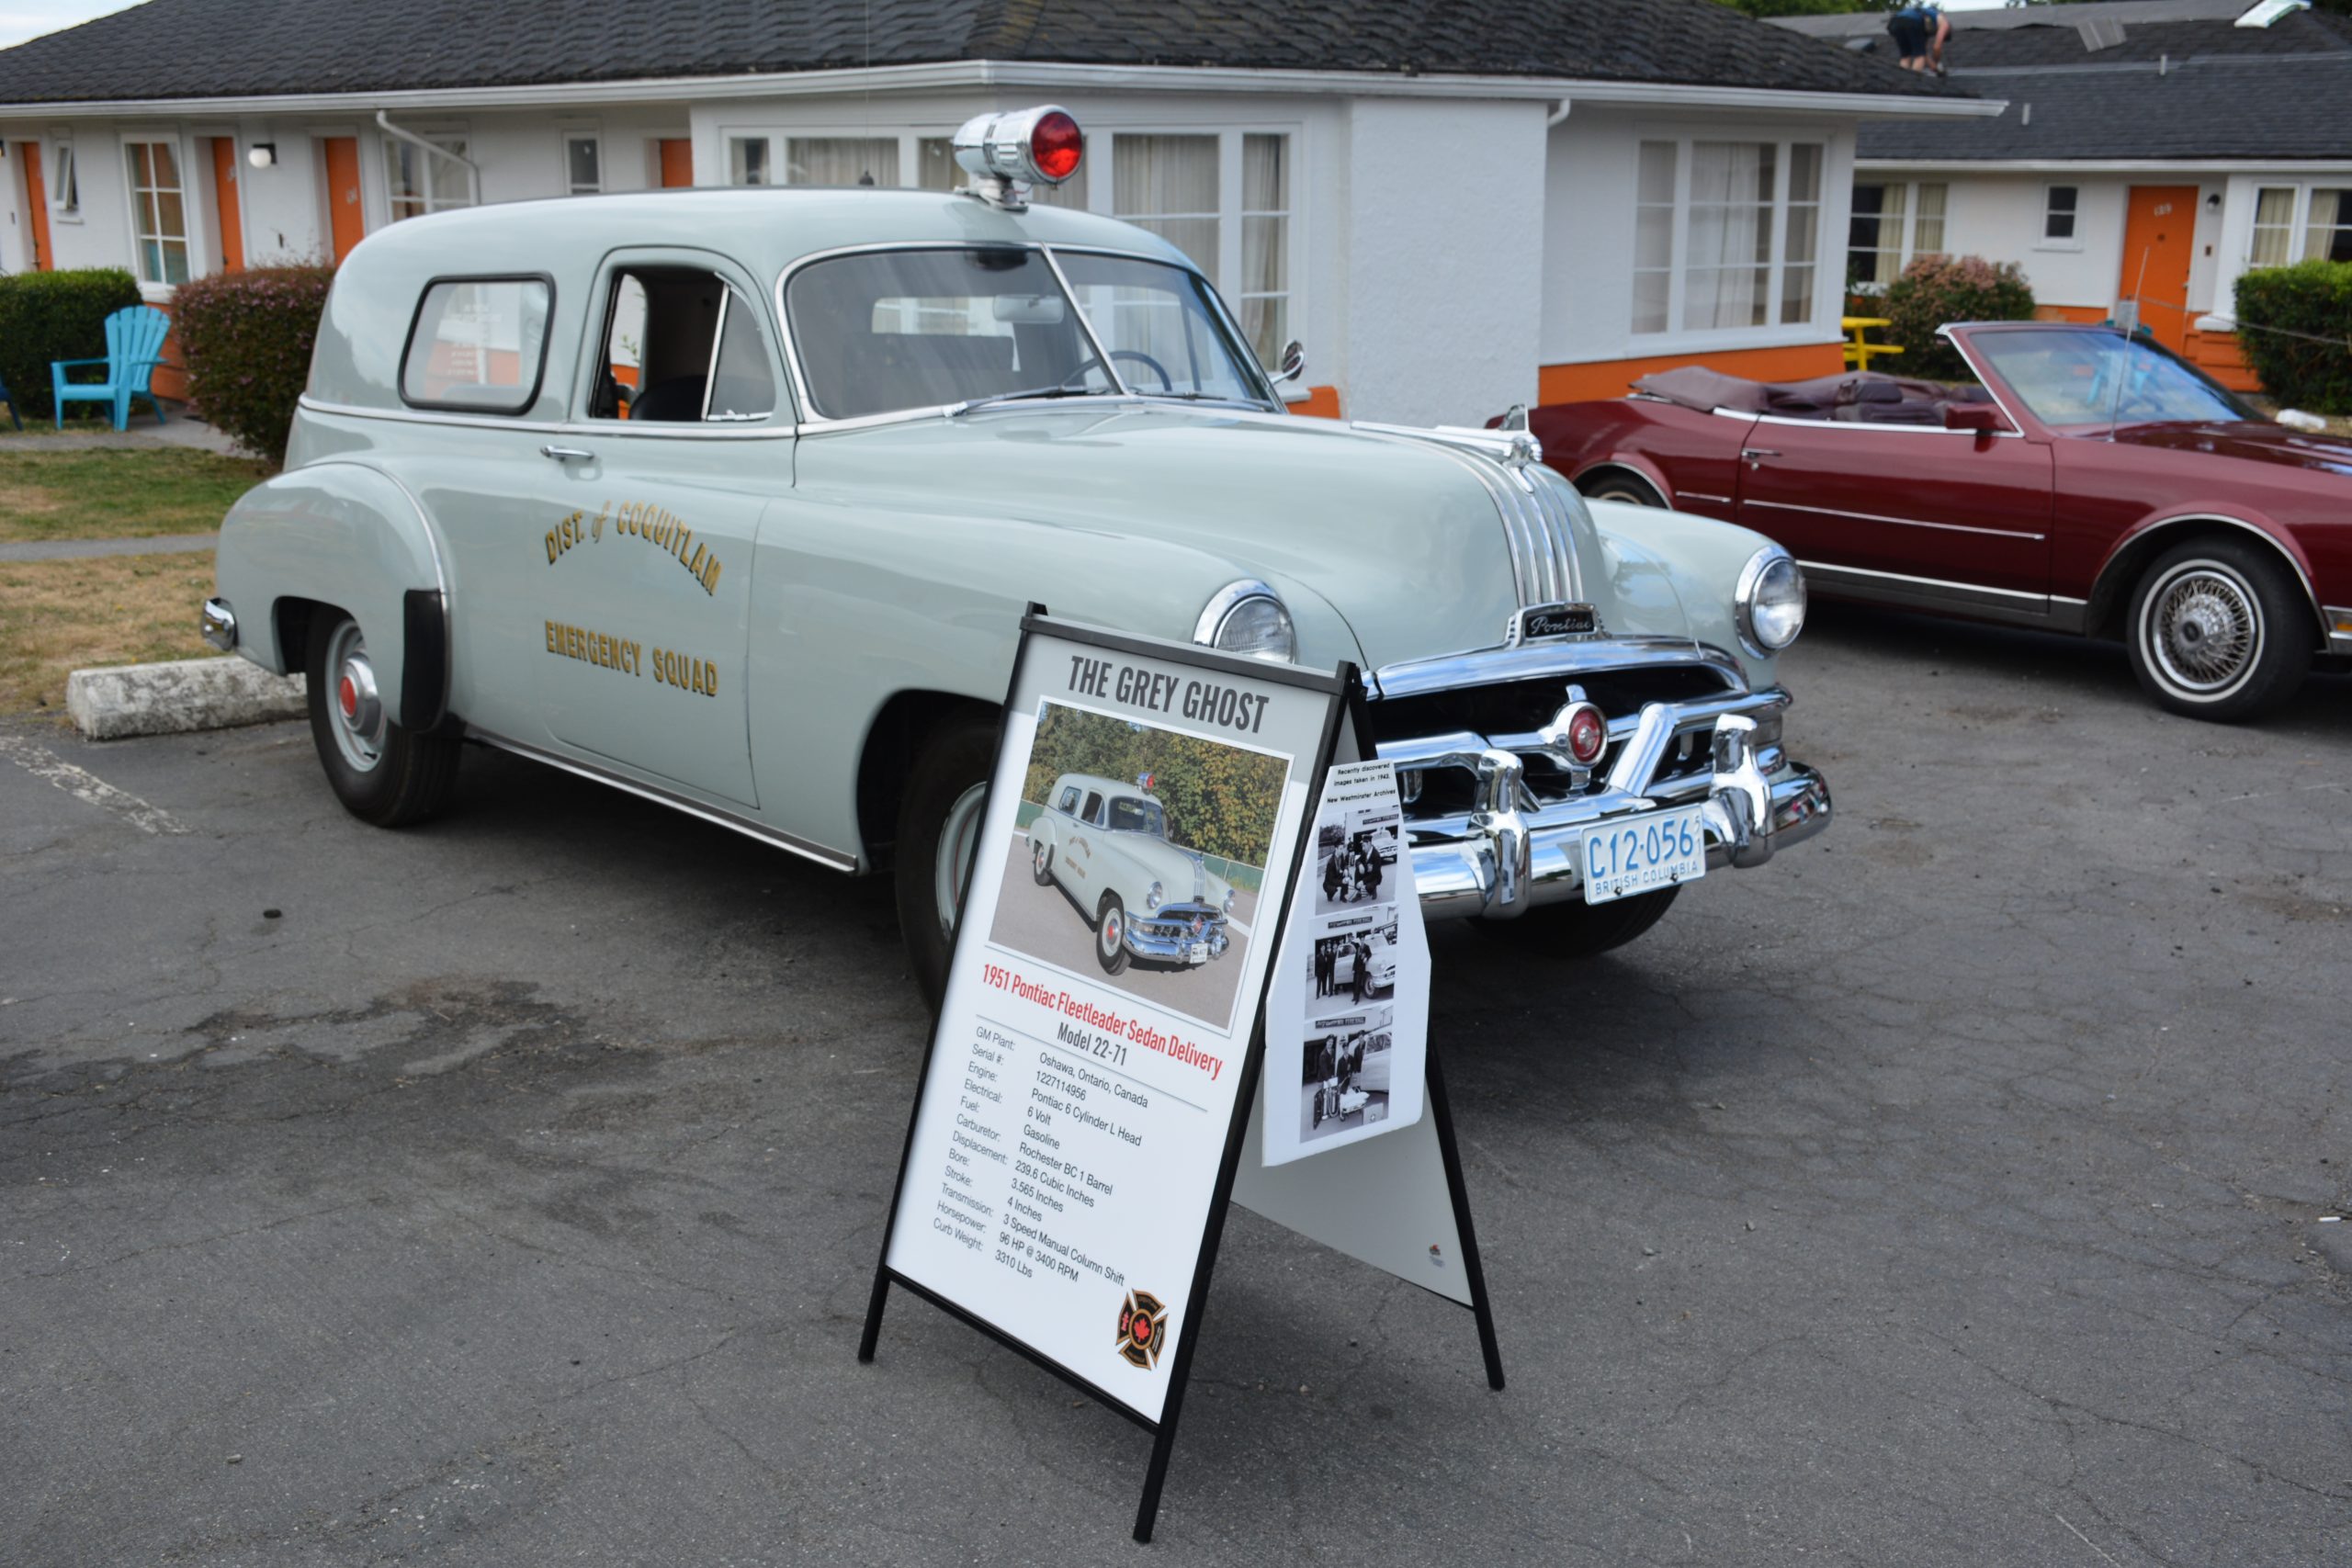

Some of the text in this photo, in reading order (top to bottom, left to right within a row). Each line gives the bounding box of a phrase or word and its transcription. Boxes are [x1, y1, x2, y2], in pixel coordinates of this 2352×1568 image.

[545, 500, 723, 597] DIST. of COQUITLAM
[1531, 615, 1592, 635] Pontiac
[545, 619, 718, 697] EMERGENCY SQUAD
[1068, 655, 1270, 734] THE GREY GHOST
[1338, 763, 1390, 775] Recently discovered
[1340, 793, 1372, 801] Westminster
[1596, 861, 1698, 895] BRITISH COLUMBIA
[976, 1026, 1015, 1051] GM Plant:
[982, 964, 1224, 1081] 1951 Pontiac Fleetleader Sedan Delivery
[972, 1043, 1004, 1066] Serial #:
[1057, 1021, 1128, 1066] Model 22-71
[967, 1061, 997, 1083] Engine:
[1035, 1070, 1087, 1101] 1227114956
[1039, 1052, 1148, 1108] Oshawa, Ontario, Canada
[960, 1096, 980, 1112] Fuel:
[964, 1078, 1003, 1104] Electrical:
[956, 1113, 1001, 1142] Carburetor:
[1027, 1106, 1051, 1126] 6 Volt
[1031, 1088, 1142, 1146] Pontiac 6 Cylinder L Head
[953, 1131, 1009, 1166] Displacement:
[1023, 1124, 1060, 1150] Gasoline
[948, 1148, 970, 1167] Bore:
[1019, 1142, 1114, 1196] Rochester BC 1 Barrel
[944, 1166, 972, 1188] Stroke:
[1015, 1159, 1095, 1208] 239.6 Cubic Inches
[942, 1182, 994, 1217] Transmission:
[1007, 1196, 1043, 1222] 4 Inches
[1011, 1178, 1064, 1213] 3.565 Inches
[937, 1200, 987, 1233] Horsepower:
[933, 1218, 984, 1252] Curb Weight:
[1003, 1213, 1125, 1286] 3 Speed Manual Column Shift
[995, 1249, 1033, 1280] 3310 Lbs
[999, 1232, 1080, 1282] 96 HP @ 3400 RPM
